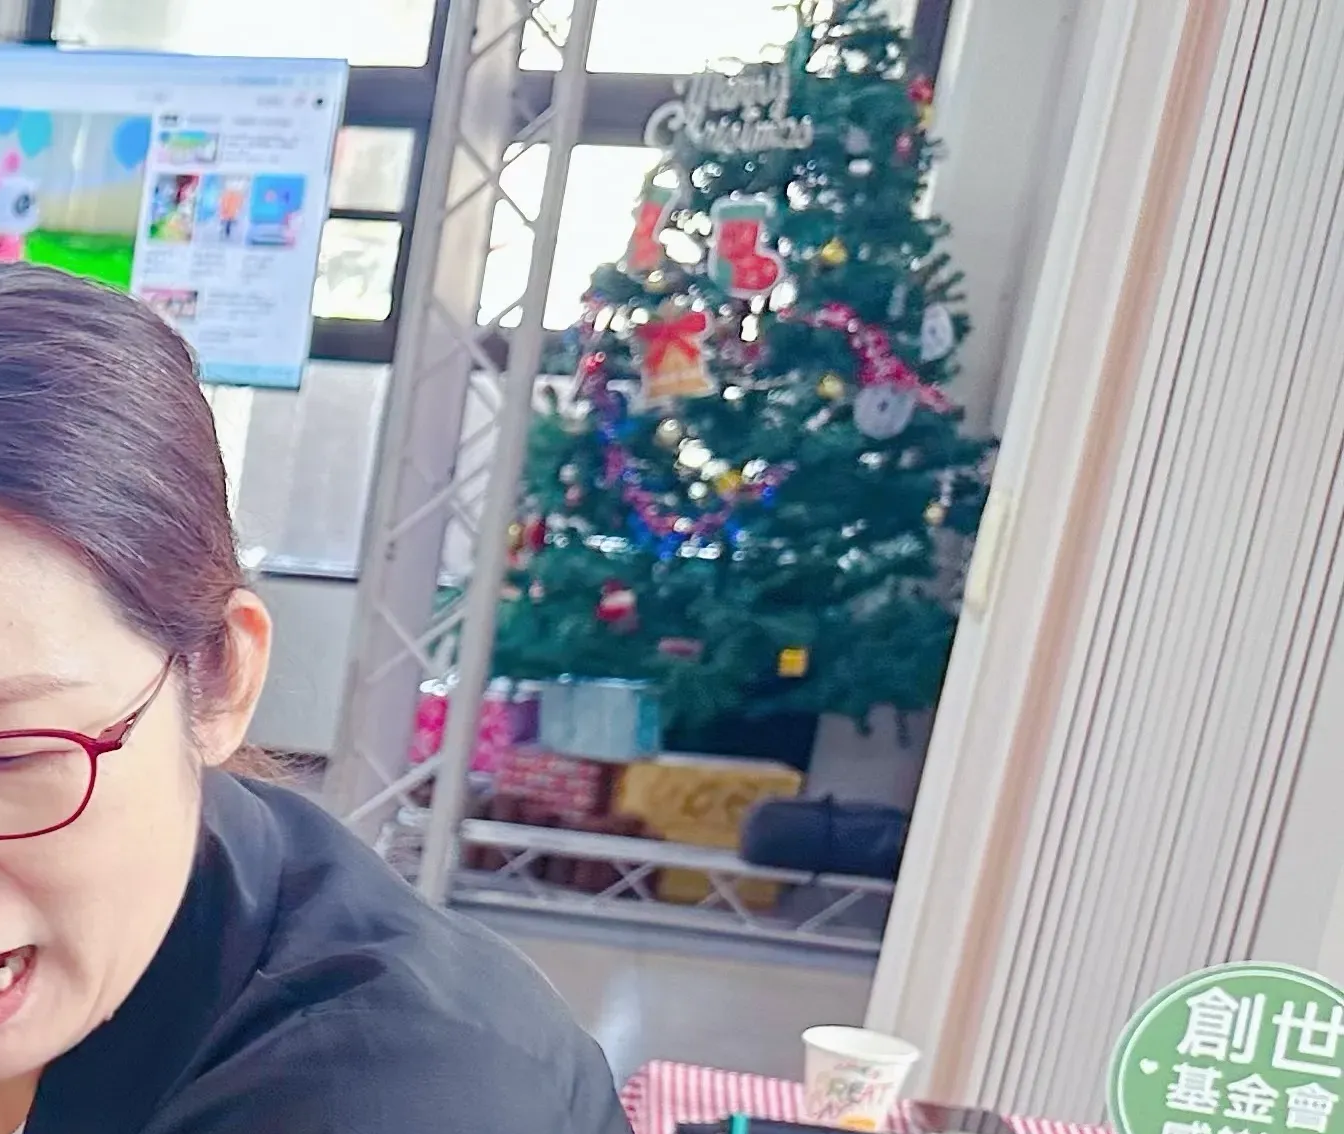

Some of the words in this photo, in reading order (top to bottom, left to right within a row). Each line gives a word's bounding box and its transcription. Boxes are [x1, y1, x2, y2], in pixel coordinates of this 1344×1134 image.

[1177, 986, 1344, 1078] 創世
[1165, 1062, 1340, 1133] 基金會
